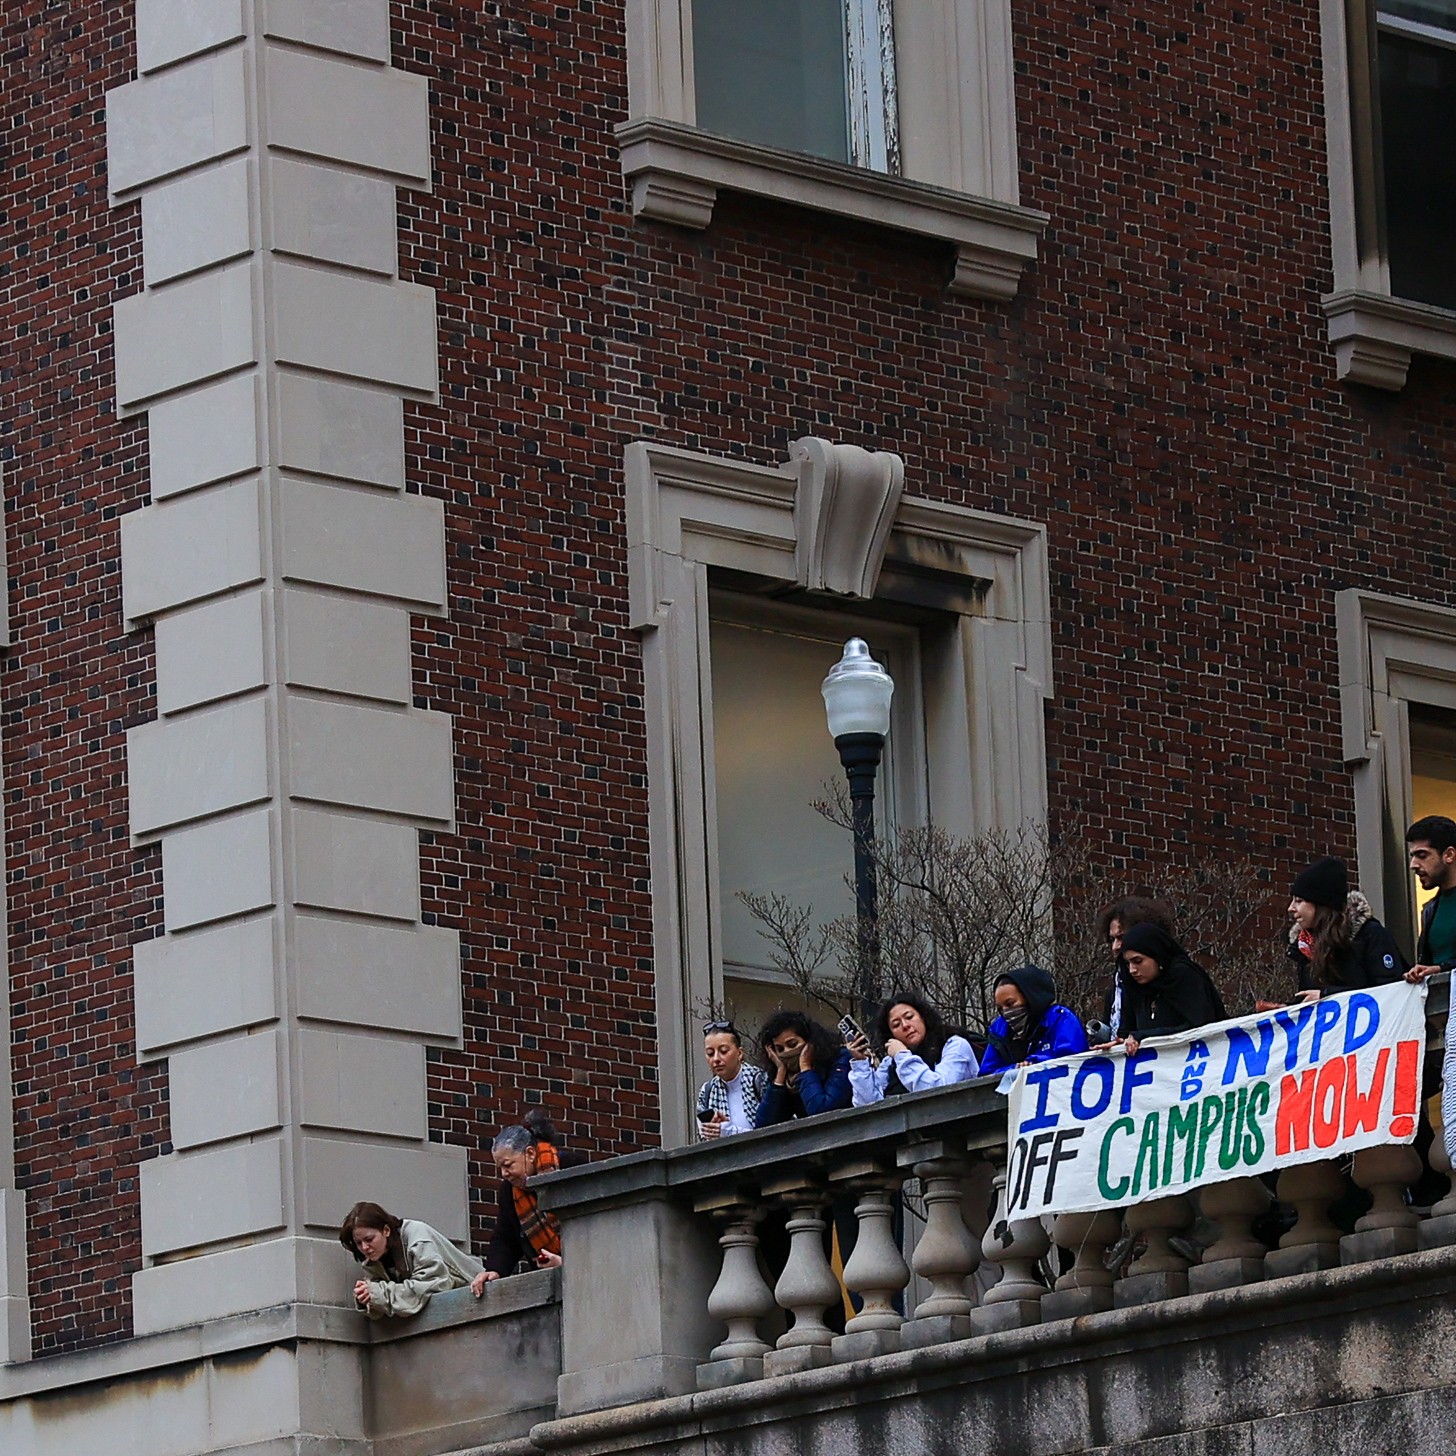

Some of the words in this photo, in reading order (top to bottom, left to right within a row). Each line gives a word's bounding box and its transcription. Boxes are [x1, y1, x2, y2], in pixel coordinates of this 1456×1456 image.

[1019, 1047, 1158, 1134] IOF
[1222, 993, 1380, 1085] NYPD
[1097, 1081, 1270, 1201] CAMPUS
[1275, 1040, 1419, 1156] NOW!
